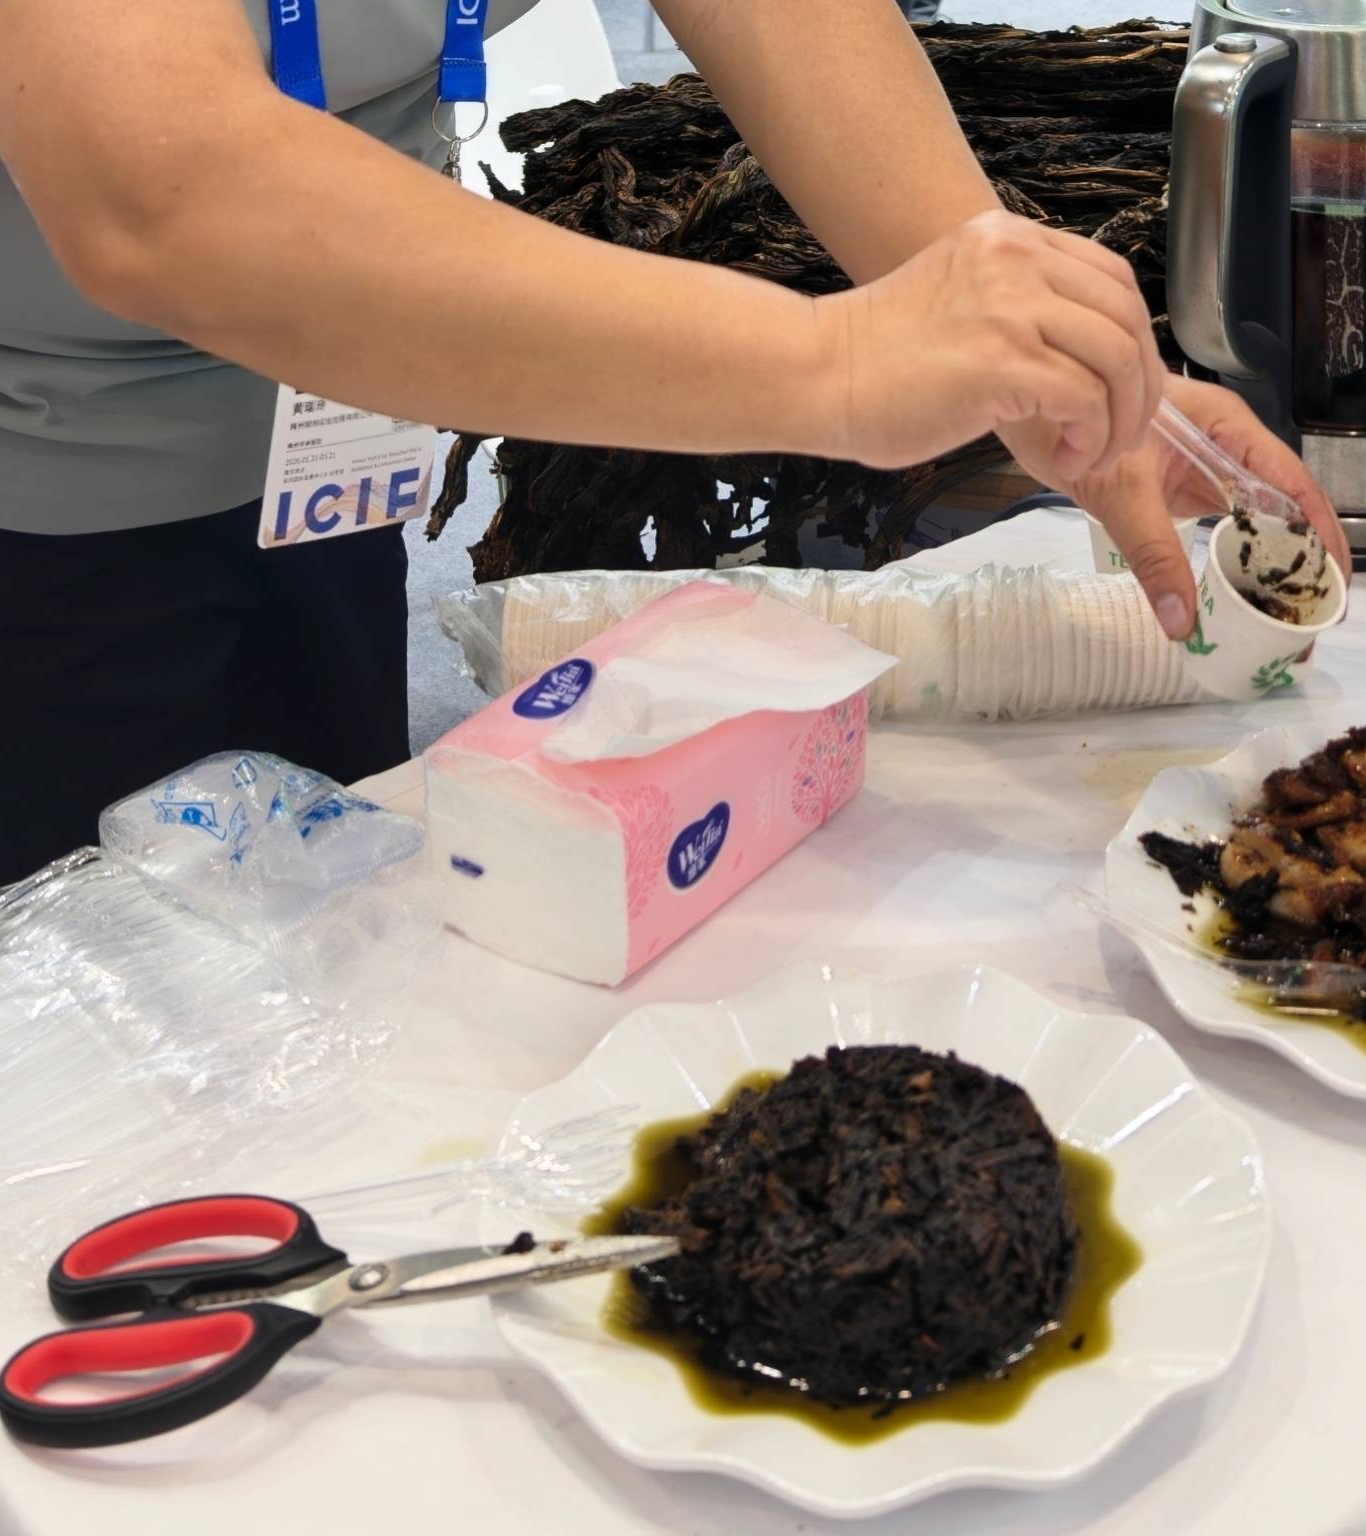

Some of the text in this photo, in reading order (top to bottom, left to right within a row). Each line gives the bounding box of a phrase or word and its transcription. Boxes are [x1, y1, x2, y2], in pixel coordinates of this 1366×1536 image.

[274, 467, 421, 540] ICIF
[1108, 550, 1130, 569] TE
[1198, 574, 1215, 616] TEA
